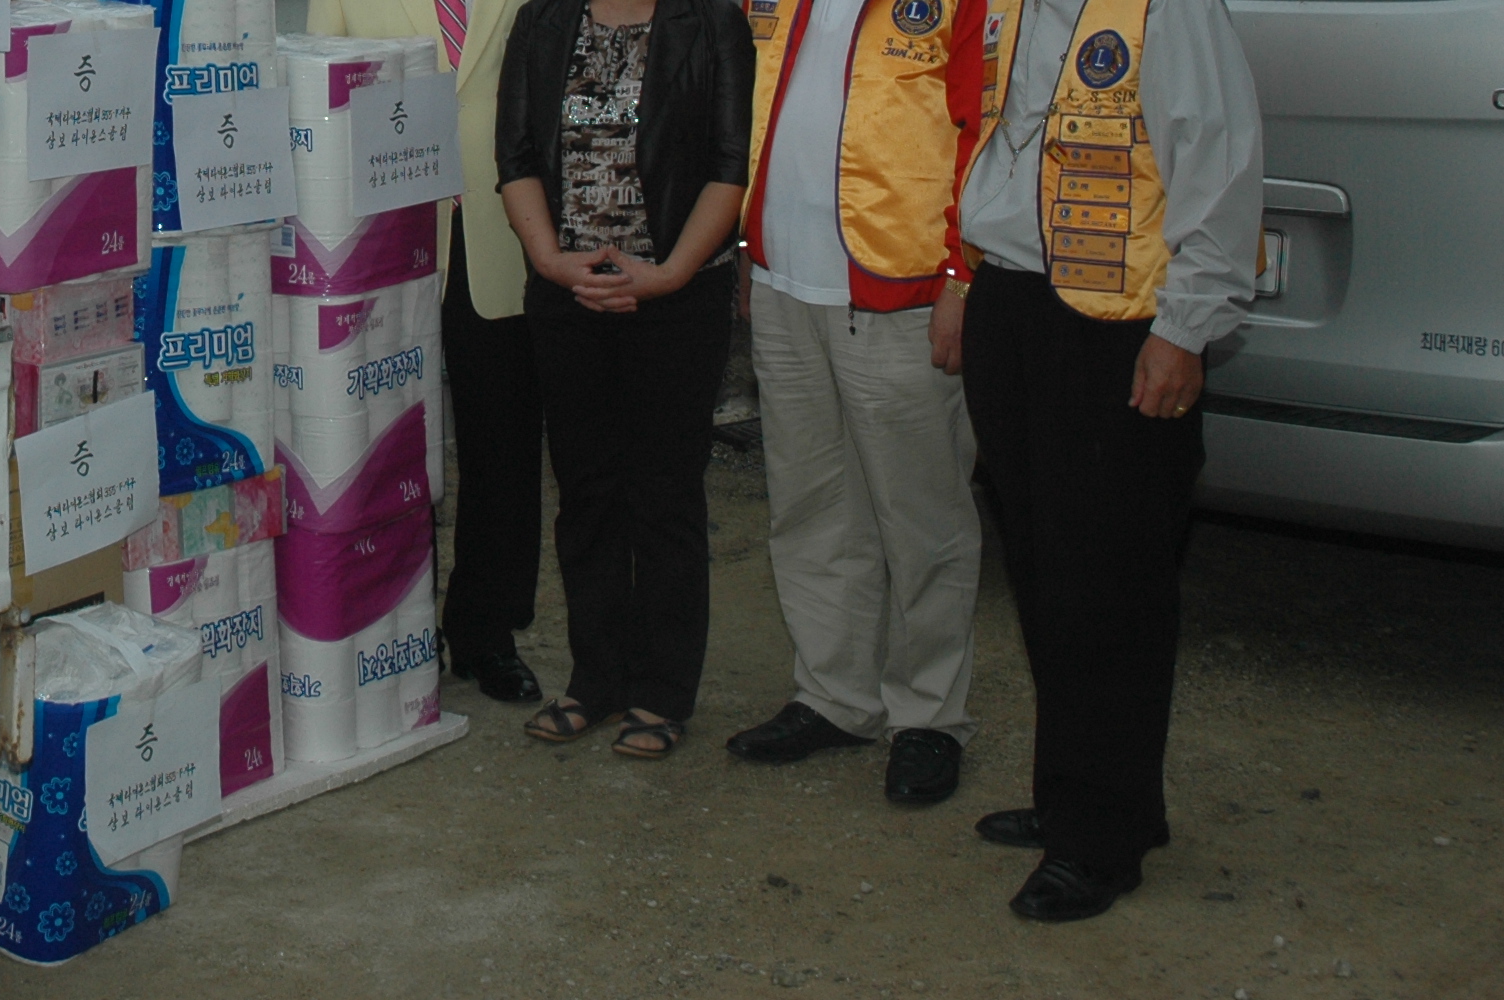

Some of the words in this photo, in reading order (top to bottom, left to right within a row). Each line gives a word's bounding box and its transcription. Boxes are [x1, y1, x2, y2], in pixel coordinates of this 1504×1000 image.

[909, 2, 920, 19] L
[73, 55, 96, 93] 증
[217, 113, 238, 149] 증
[389, 101, 408, 134] 증
[162, 323, 254, 367] 프리미엄
[1420, 332, 1488, 356] 최대적재량
[347, 346, 423, 400] 기획화장지
[70, 440, 94, 476] 증
[135, 723, 158, 762] 증
